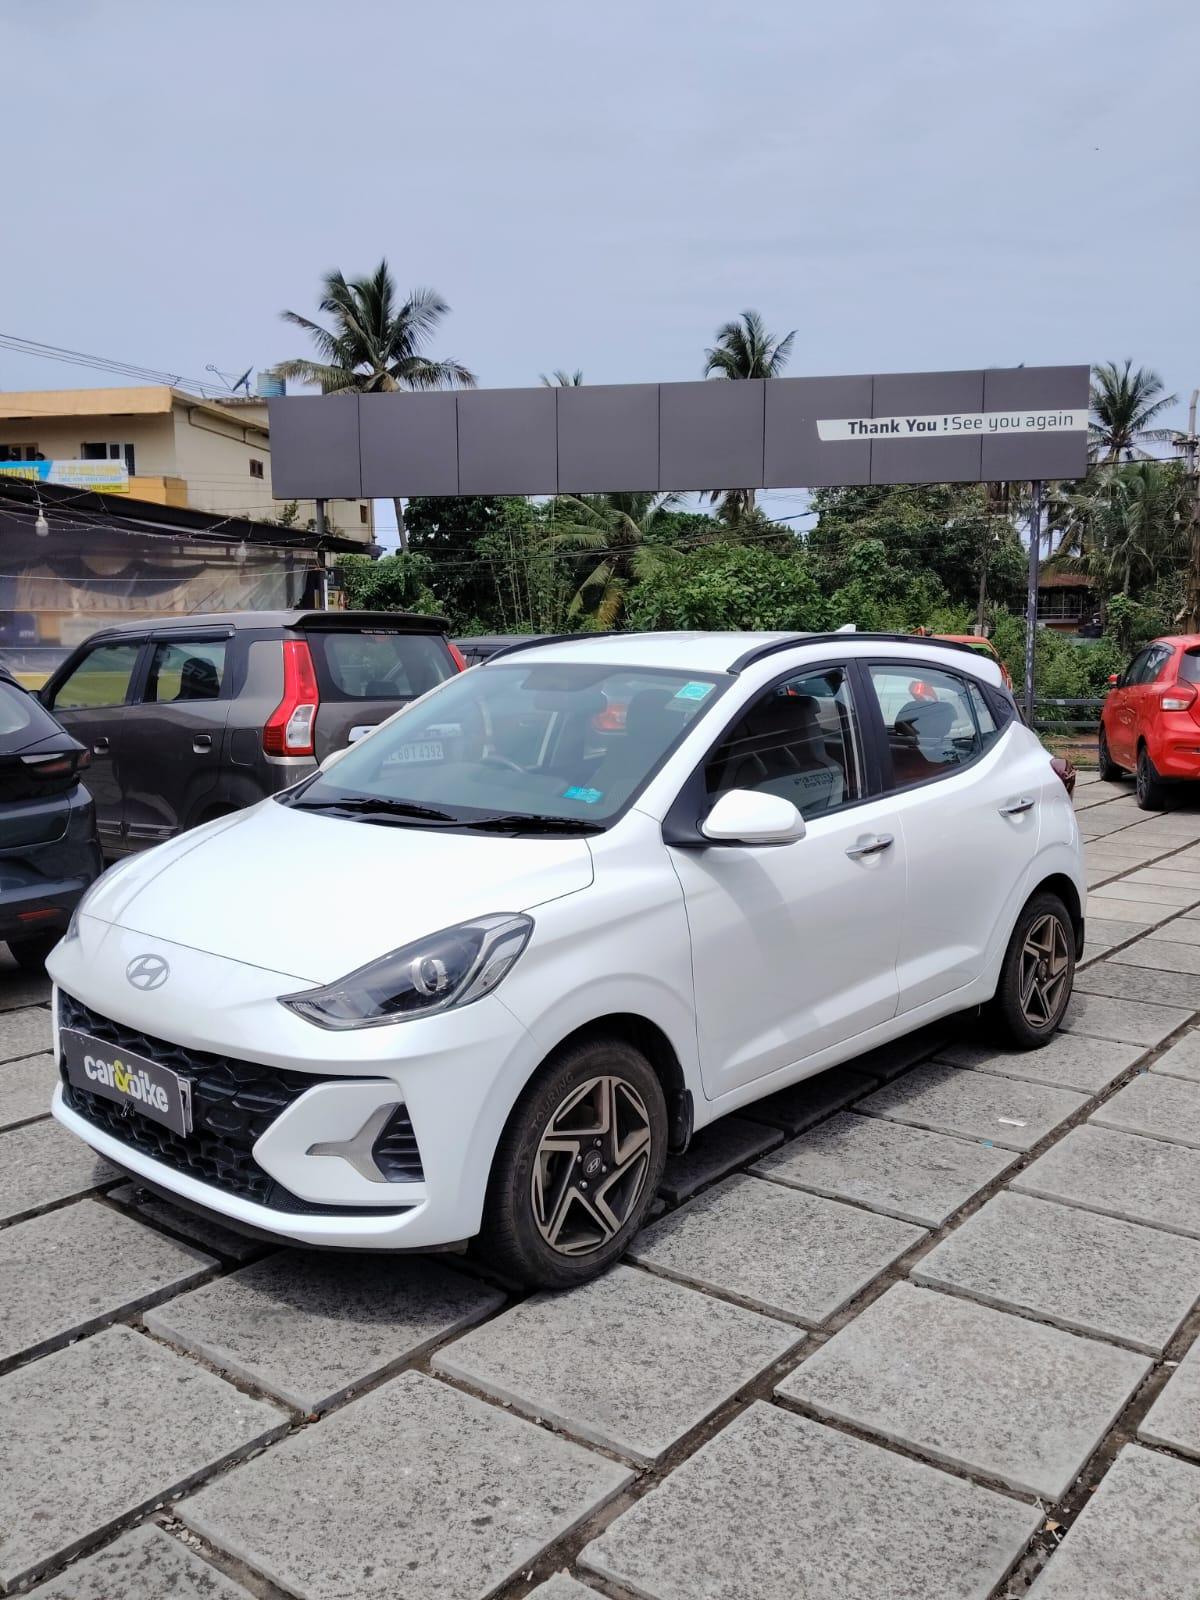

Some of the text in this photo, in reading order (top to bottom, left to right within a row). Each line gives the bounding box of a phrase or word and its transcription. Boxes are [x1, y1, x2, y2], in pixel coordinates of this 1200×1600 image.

[848, 418, 900, 435] Thank
[906, 418, 937, 432] You
[988, 415, 1020, 431] you
[1025, 411, 1074, 431] again
[83, 1055, 169, 1113] car&bike
